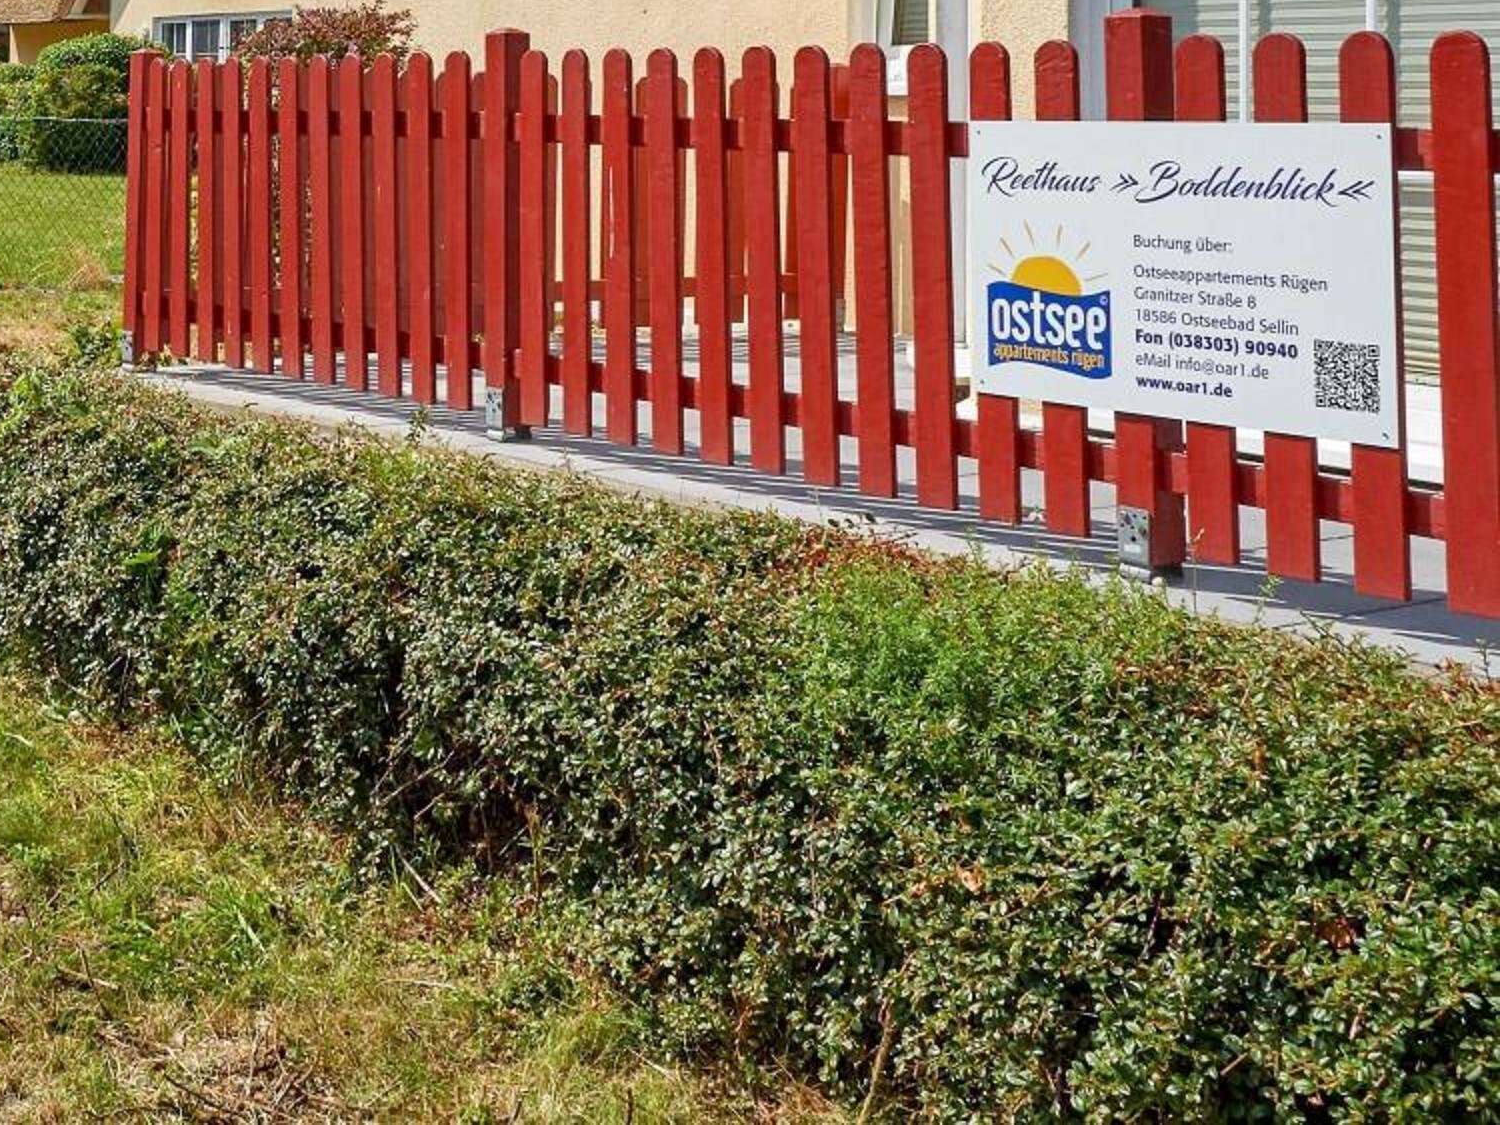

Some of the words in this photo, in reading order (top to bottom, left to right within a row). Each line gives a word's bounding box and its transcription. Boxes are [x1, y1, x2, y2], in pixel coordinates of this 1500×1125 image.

[981, 156, 1102, 198] Reethaus
[1133, 234, 1192, 254] Buchung
[1196, 236, 1233, 253] über:
[1133, 264, 1277, 288] Ostseeappartements
[1280, 273, 1329, 294] Rügen
[1134, 286, 1194, 304] Granitzer
[1199, 290, 1243, 308] Straße
[1247, 296, 1257, 310] 8
[991, 291, 1107, 350] ostsee
[1136, 308, 1177, 325] 18586
[1181, 312, 1256, 332] Ostseebad
[1259, 318, 1300, 336] Sellin
[994, 342, 1069, 365] appartements
[1071, 348, 1106, 372] rügen
[1135, 328, 1163, 345] Fon
[1169, 331, 1239, 357] (038303)
[1245, 340, 1299, 359] 90940
[1135, 352, 1171, 368] eMail
[1175, 355, 1270, 379] info@oar1.de
[1136, 376, 1233, 398] www.oar1.de
